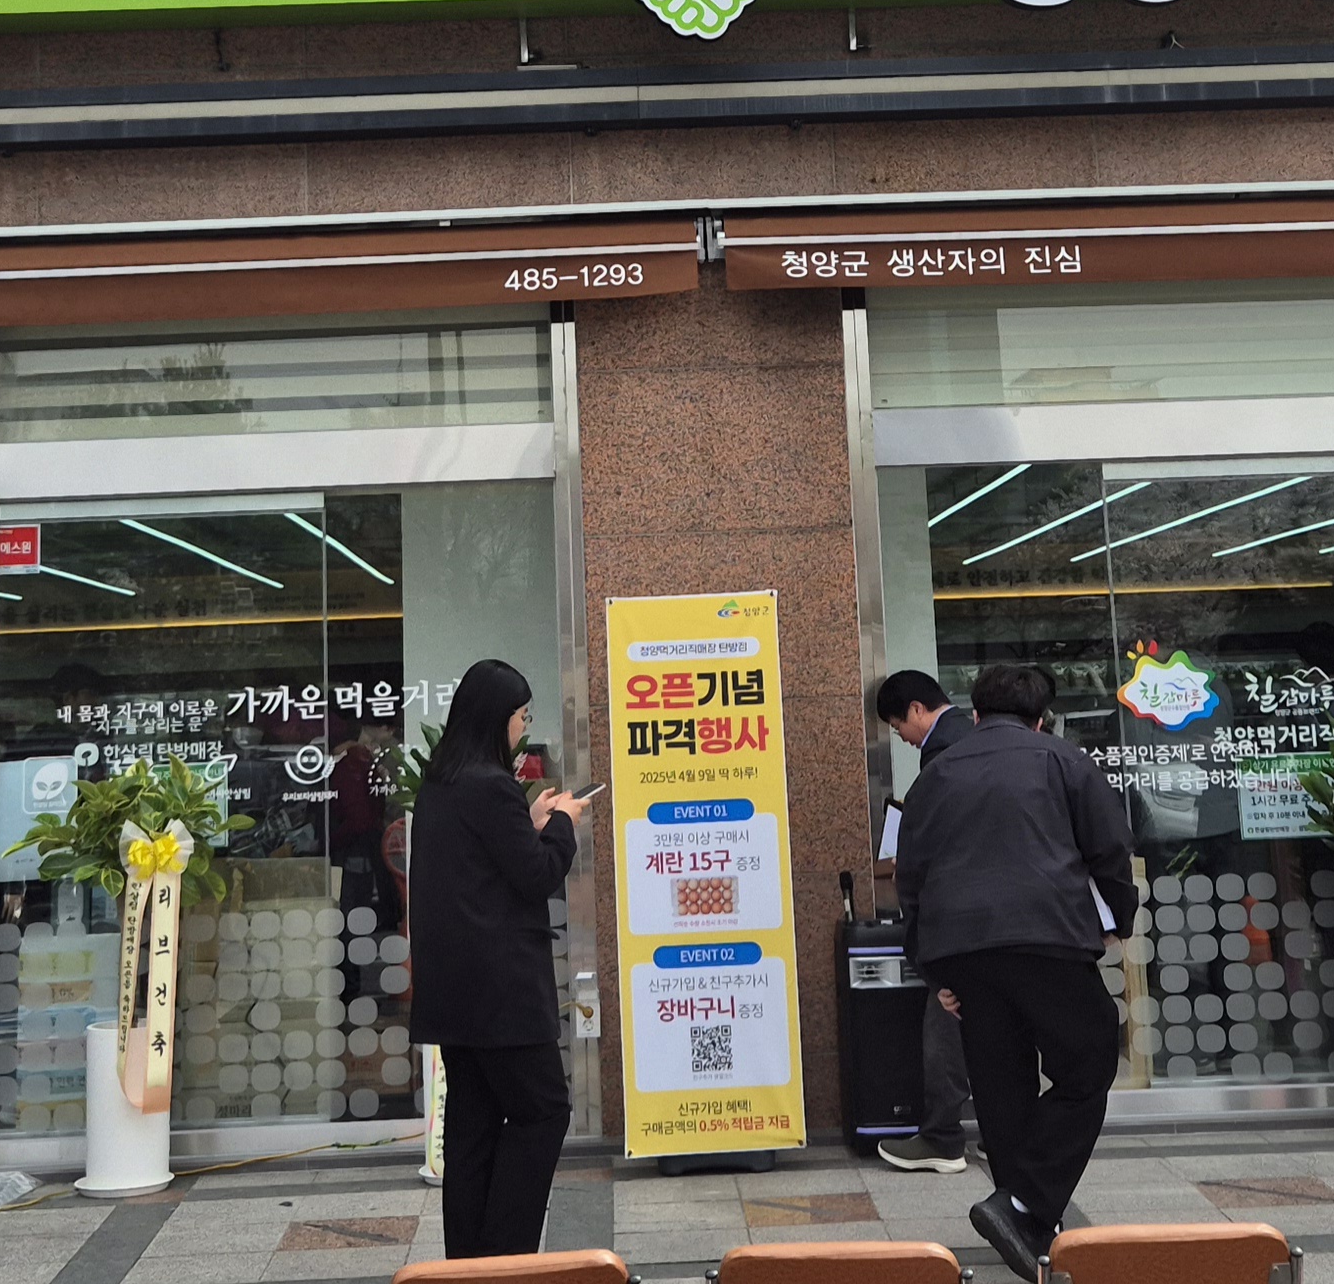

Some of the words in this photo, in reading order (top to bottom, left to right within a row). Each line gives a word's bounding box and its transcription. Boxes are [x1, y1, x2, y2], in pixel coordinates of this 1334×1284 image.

[781, 250, 869, 278] 청양군
[887, 248, 1006, 276] 생산자의
[1024, 245, 1082, 274] 진심
[504, 263, 644, 291] 485-1293
[0, 541, 32, 555] 에스원
[625, 669, 765, 709] 오픈기념
[1140, 681, 1202, 708] 칠갑마루
[57, 705, 72, 723] 내
[76, 704, 110, 723] 몸과
[117, 701, 164, 720] 지구에
[169, 699, 218, 718] 이로운
[226, 684, 329, 723] 가까운
[142, 717, 184, 734] 살리는
[627, 715, 769, 756] 파격행사
[103, 743, 153, 765] 한살림
[156, 741, 223, 762] 탄방매장
[1080, 743, 1207, 767] 수품질인증제'로
[640, 769, 676, 784] 2025년
[679, 769, 696, 783] 4월
[698, 767, 716, 782] 9일
[733, 767, 758, 780] 하루!
[1107, 772, 1174, 792] 먹거리를
[369, 785, 399, 796] 가까운
[1251, 795, 1276, 806] 1시간
[1279, 794, 1300, 806] 무료
[674, 806, 711, 819] EVENT
[714, 805, 728, 817] 01
[654, 833, 684, 847] 3만원
[688, 832, 710, 845] 이상
[714, 830, 750, 844] 구매시
[645, 853, 684, 875] 계란
[689, 851, 732, 873] 15구
[736, 856, 761, 871] 증정
[680, 949, 718, 963] EVENT
[720, 948, 735, 961] 02
[649, 977, 696, 993] 신규가입
[709, 974, 769, 990] 친구추가시
[657, 997, 736, 1022] 장바구니
[738, 1003, 764, 1019] 증정
[678, 1100, 723, 1117] 신규가입
[726, 1099, 752, 1113] 혜택!
[641, 1121, 697, 1136] 구매금액의
[699, 1119, 729, 1132] 0.5%
[731, 1117, 765, 1132] 적립금
[768, 1115, 790, 1129] 지급
